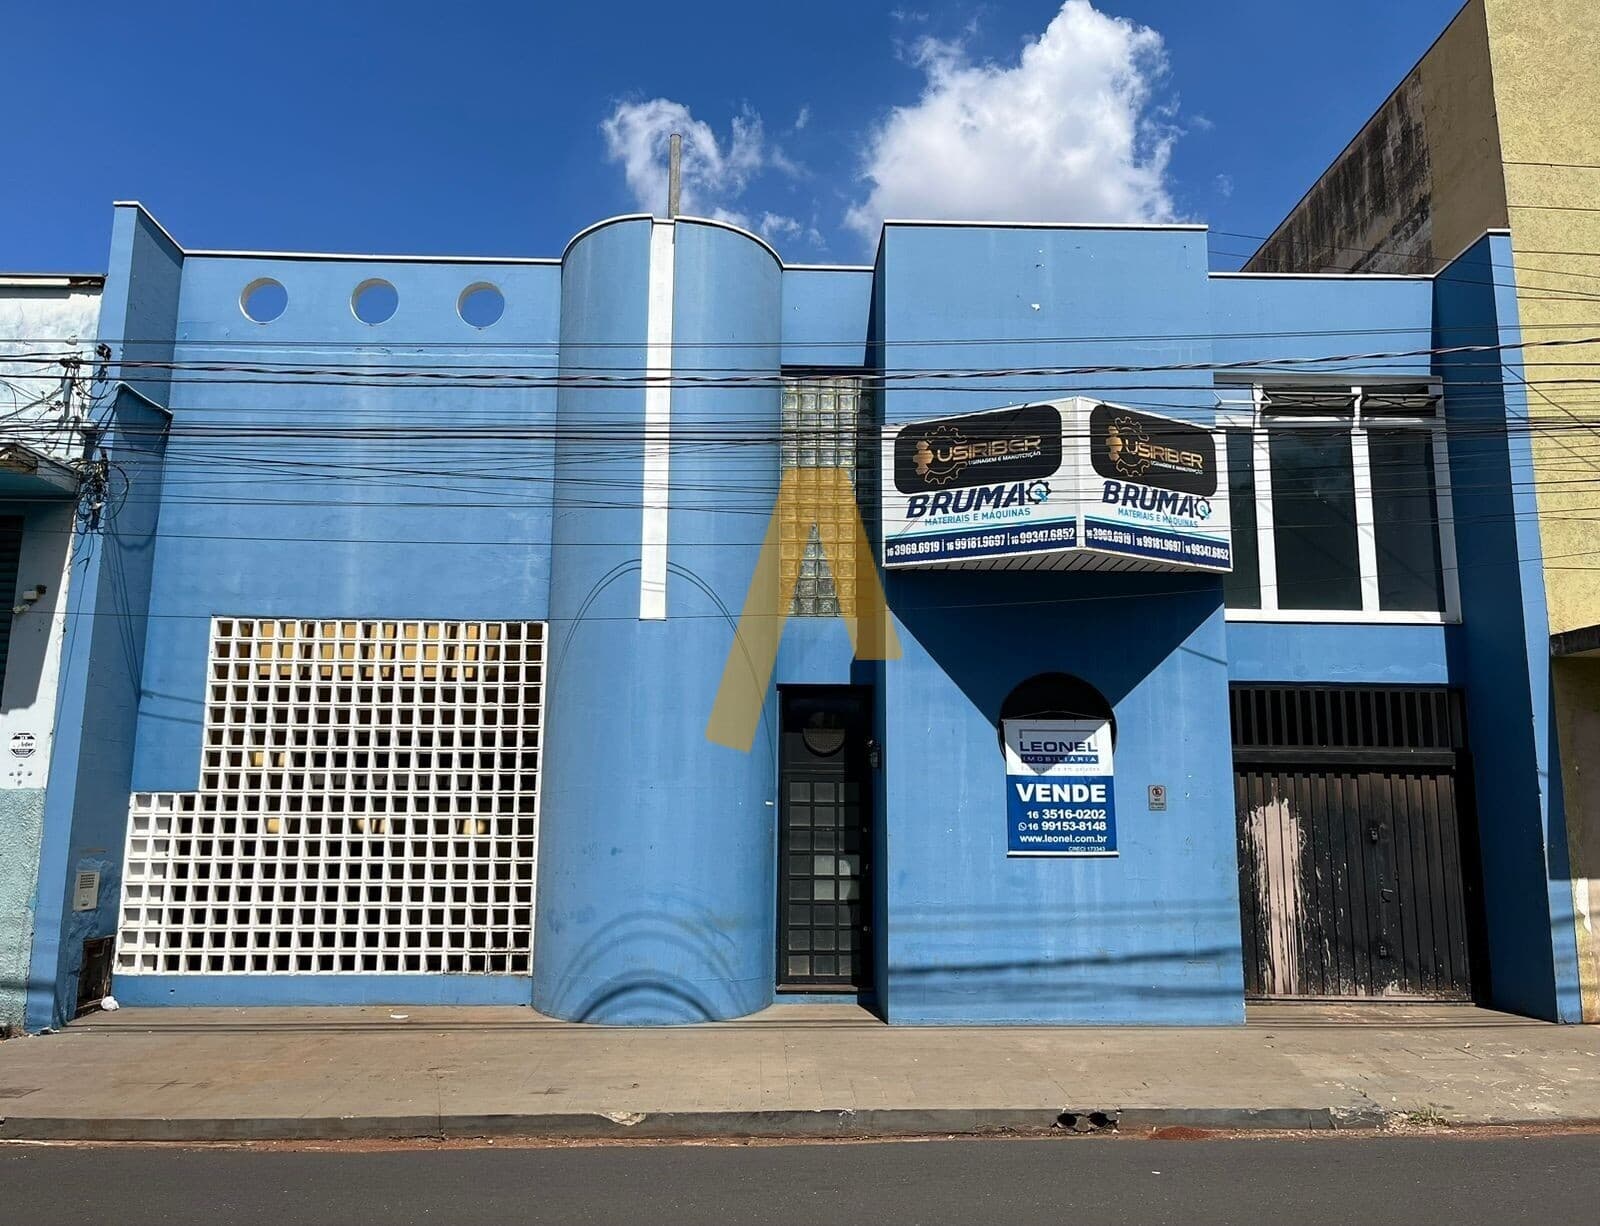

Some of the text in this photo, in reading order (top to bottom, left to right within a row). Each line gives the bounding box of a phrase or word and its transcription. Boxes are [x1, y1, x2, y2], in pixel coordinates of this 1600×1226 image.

[924, 513, 970, 526] MATERIAIS
[973, 513, 979, 521] E
[1117, 507, 1155, 522] MATERIAIS
[1156, 514, 1161, 522] E
[894, 541, 940, 556] 3969.6919
[946, 541, 954, 551] 16
[1019, 527, 1075, 544] 99347.6852
[1020, 741, 1099, 753] LEONEL
[1015, 783, 1107, 803] VENDE
[1026, 808, 1107, 820] 16 3516-0202
[1027, 821, 1107, 832] 16 99153-8148
[1019, 834, 1108, 843] www.leonel.com.br
